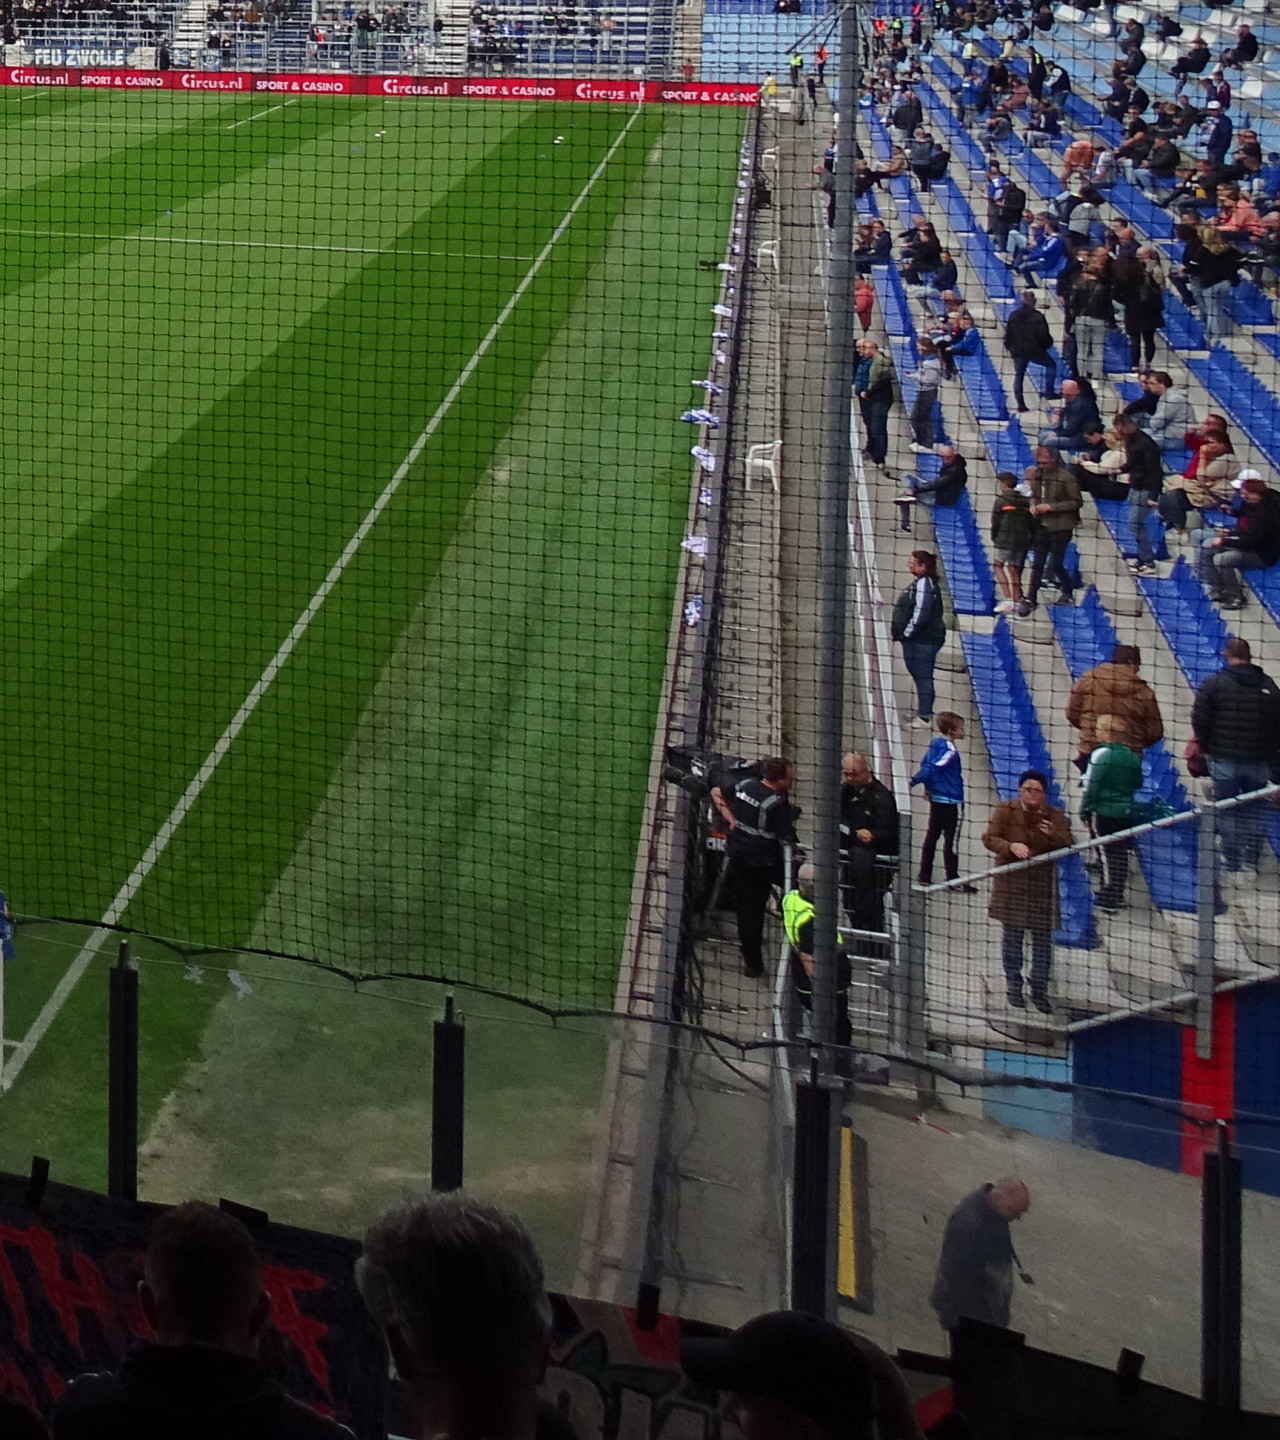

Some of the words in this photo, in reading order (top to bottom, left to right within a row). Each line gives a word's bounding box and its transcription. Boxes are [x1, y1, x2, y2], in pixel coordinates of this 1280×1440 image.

[35, 49, 62, 66] FEU
[66, 49, 124, 66] ZWOLLE
[11, 70, 68, 86] Circus.nl
[81, 75, 111, 85] SPORT
[114, 76, 122, 85] &
[125, 76, 163, 87] CASINO
[182, 74, 242, 89] Circus.nl
[256, 80, 289, 90] SPORT
[291, 81, 299, 90] &
[303, 81, 343, 91] CASINO
[383, 79, 448, 94] Circus.nl
[462, 85, 496, 95] SPORT
[512, 86, 555, 96] CASINO
[576, 82, 645, 100] Circus.nl
[661, 91, 697, 101] SPORT
[701, 91, 709, 101] &
